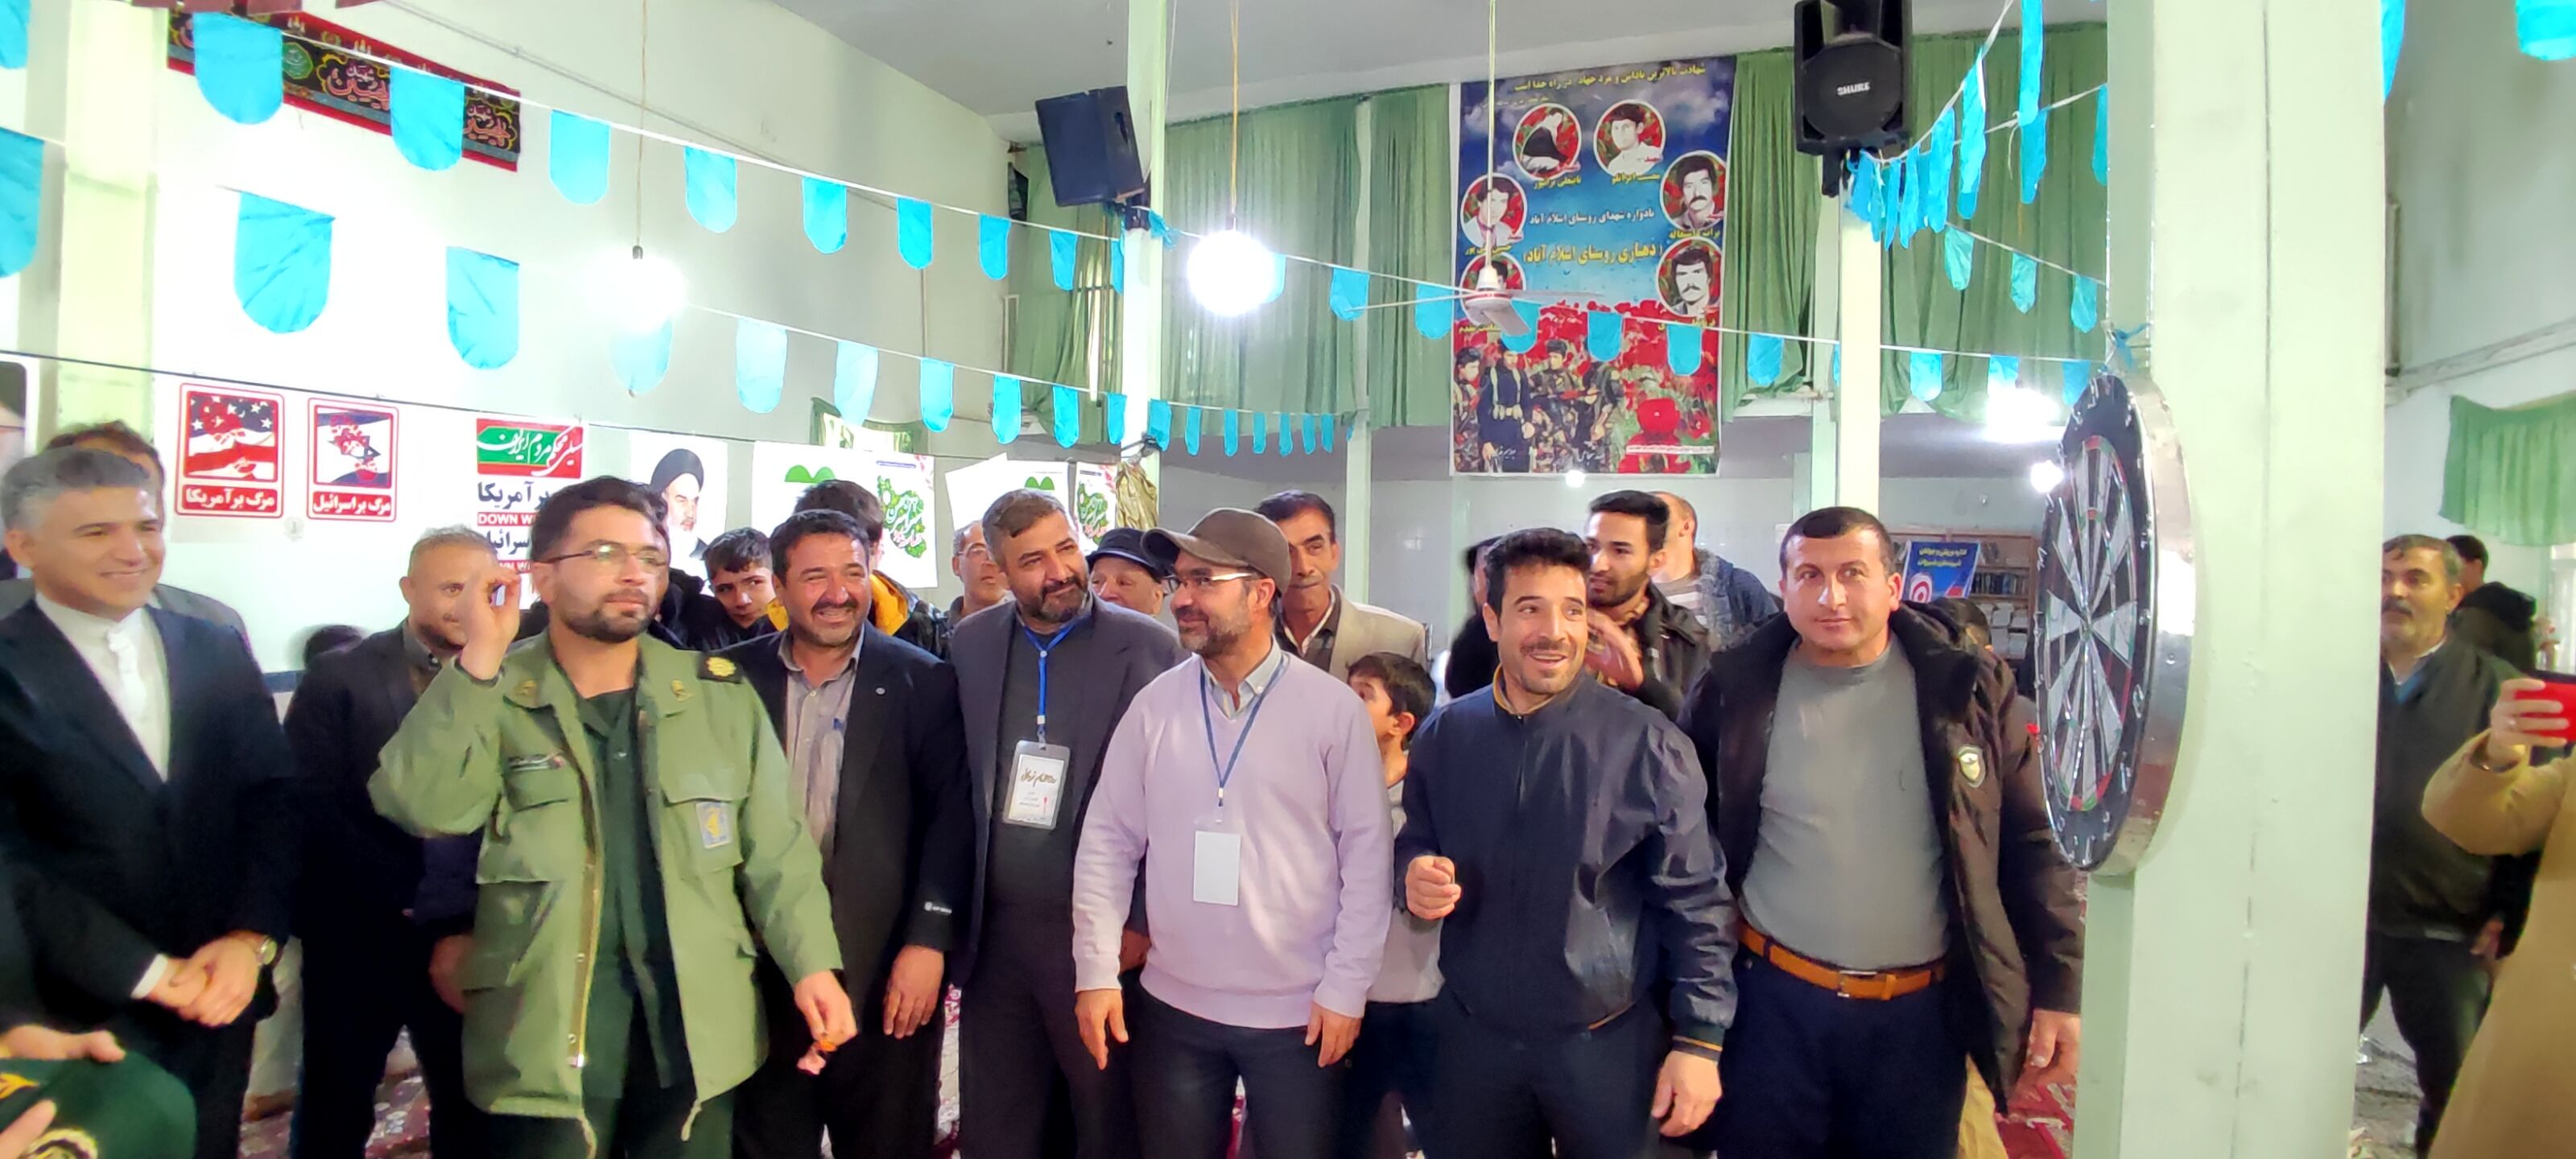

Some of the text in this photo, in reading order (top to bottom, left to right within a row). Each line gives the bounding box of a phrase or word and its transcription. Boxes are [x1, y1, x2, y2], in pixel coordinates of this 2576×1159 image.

[185, 487, 275, 510] مرگ بر آمریکا
[312, 492, 391, 515] مرگ بر اسرائیل
[477, 481, 534, 509] آمریکا
[478, 514, 518, 525] DOWN
